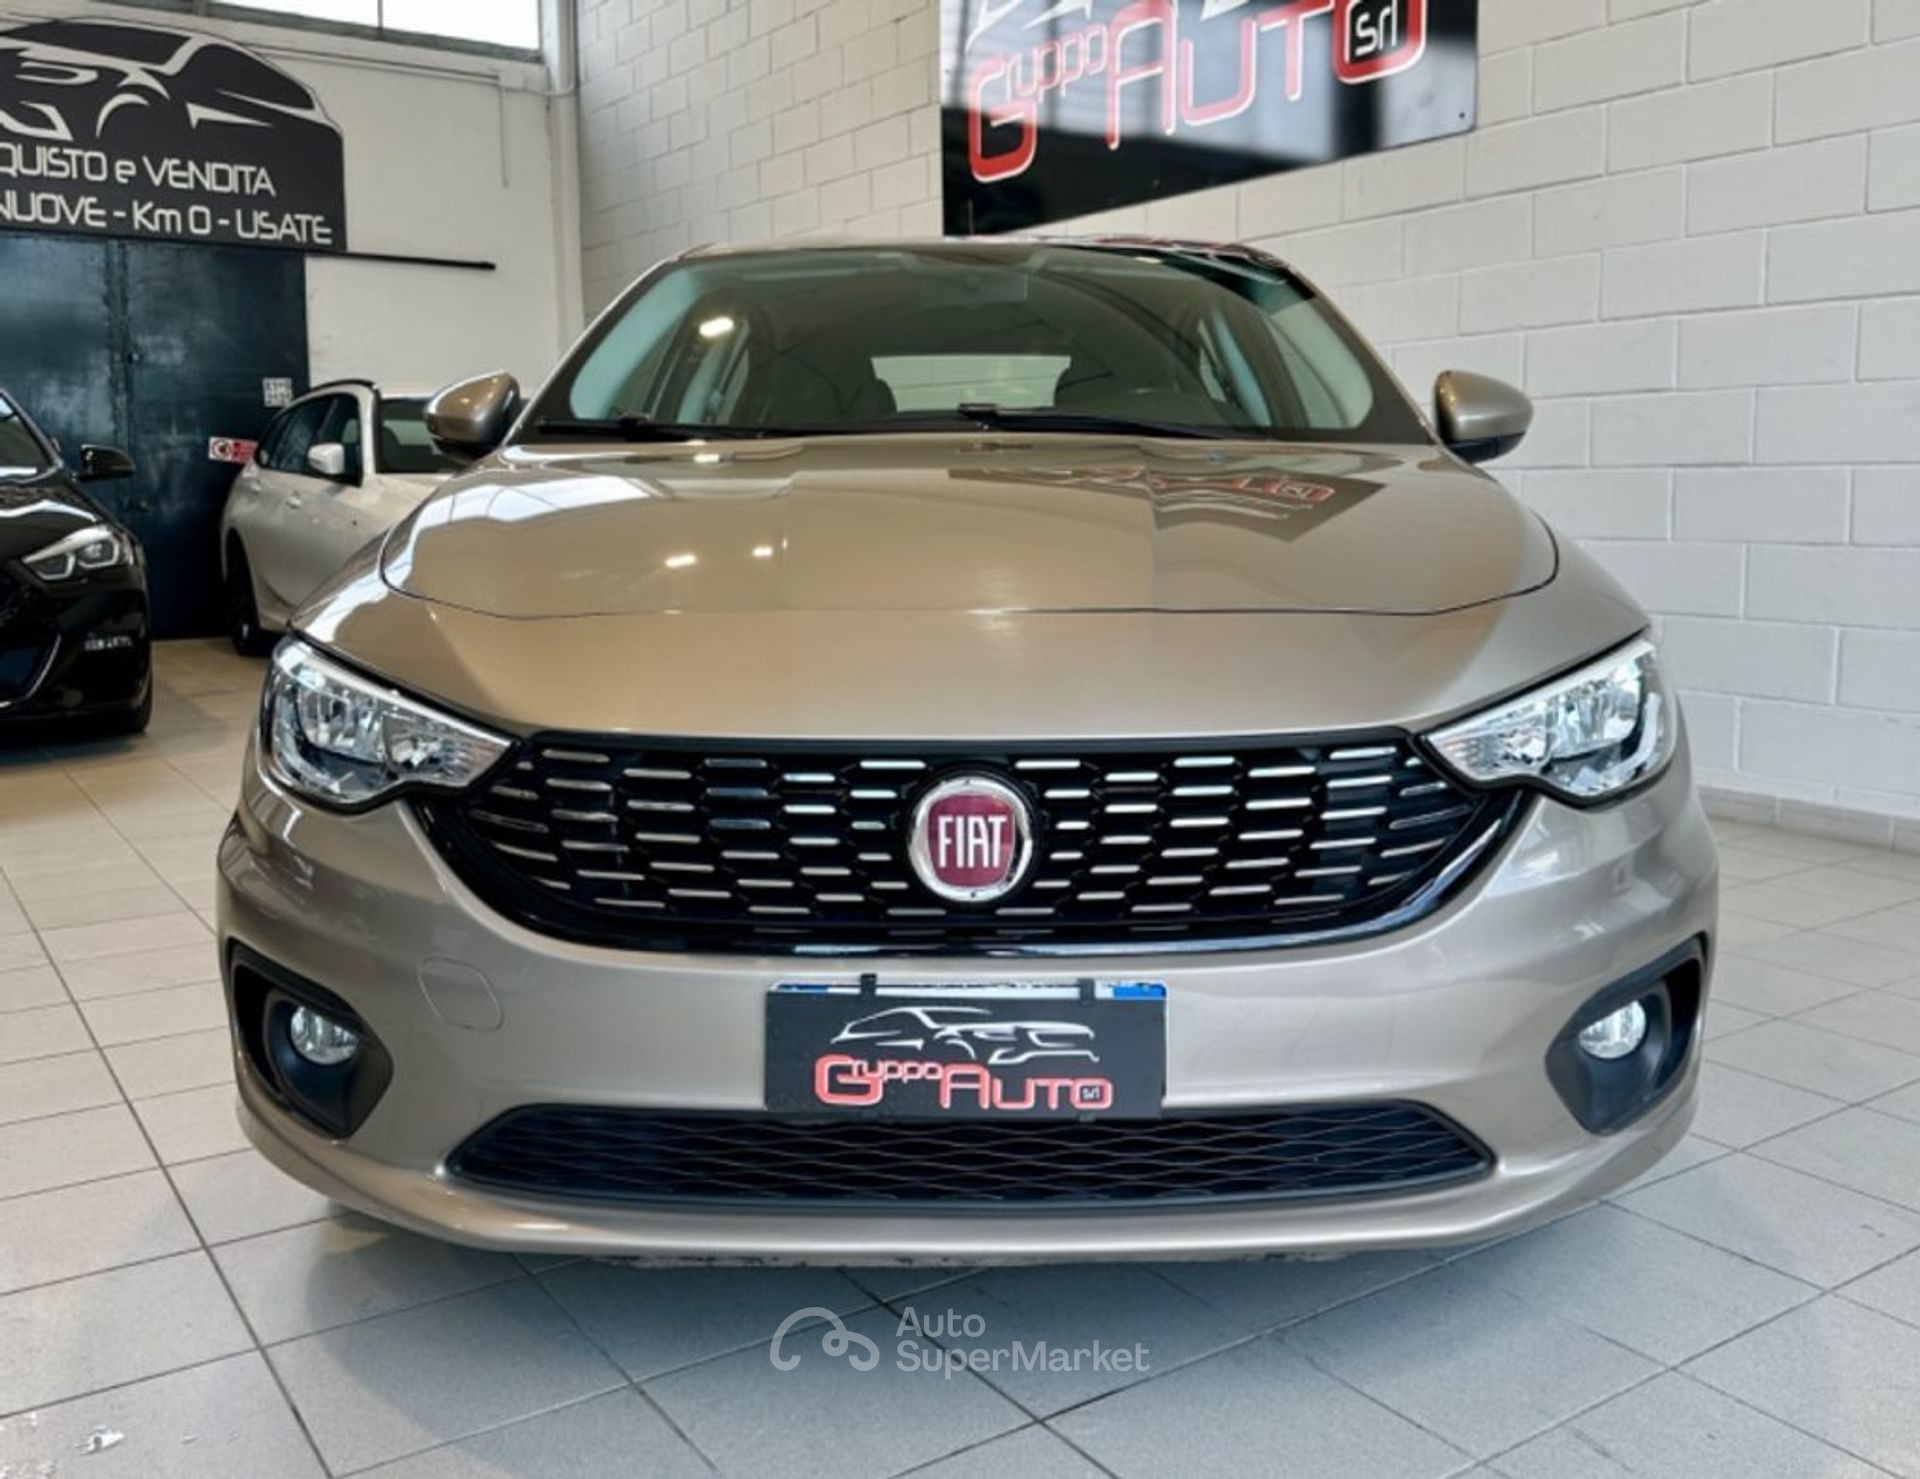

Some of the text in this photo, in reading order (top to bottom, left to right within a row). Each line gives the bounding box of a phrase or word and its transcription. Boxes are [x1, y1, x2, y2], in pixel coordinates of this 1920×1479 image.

[114, 159, 137, 184] e
[142, 154, 276, 197] VENDITA
[132, 199, 182, 235] Km
[235, 208, 333, 245] USATE
[938, 815, 1007, 868] FIAT
